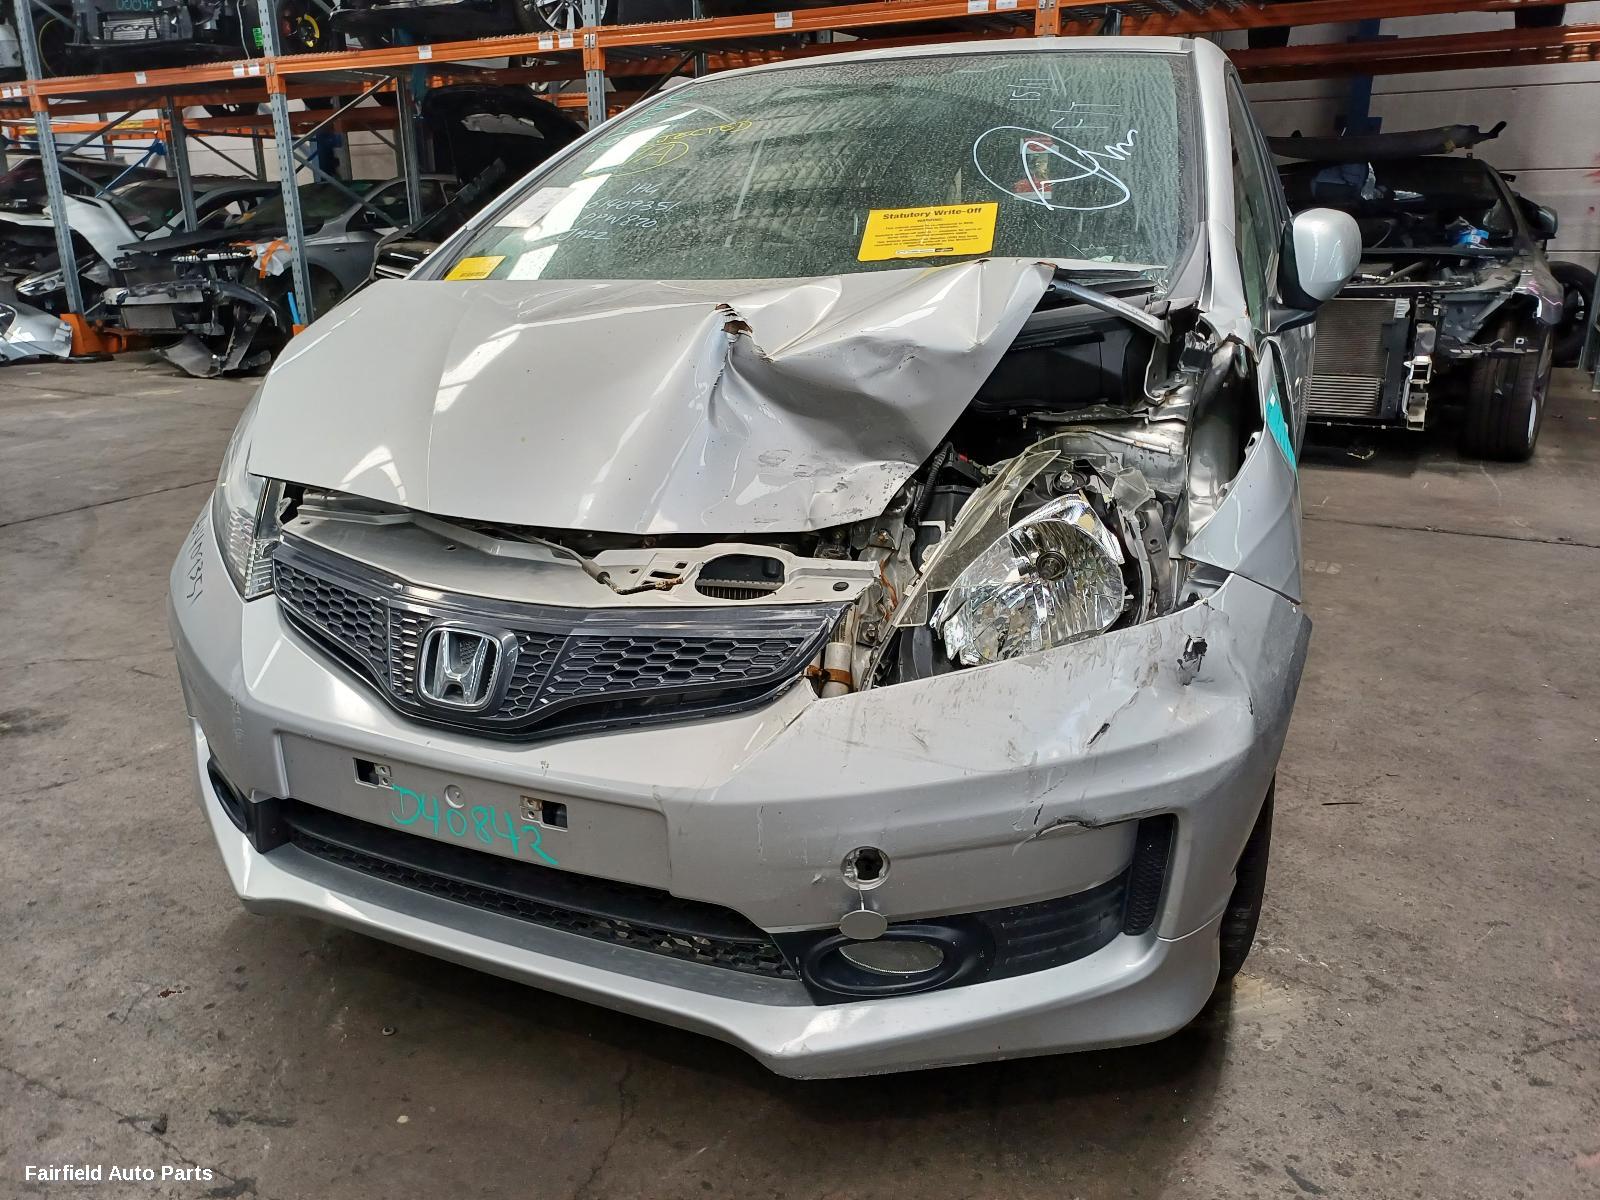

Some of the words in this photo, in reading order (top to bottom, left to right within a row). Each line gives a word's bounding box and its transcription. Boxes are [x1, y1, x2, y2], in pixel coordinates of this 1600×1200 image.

[882, 210, 931, 220] Statutory
[933, 207, 982, 217] Write-Off
[390, 783, 559, 866] D40842
